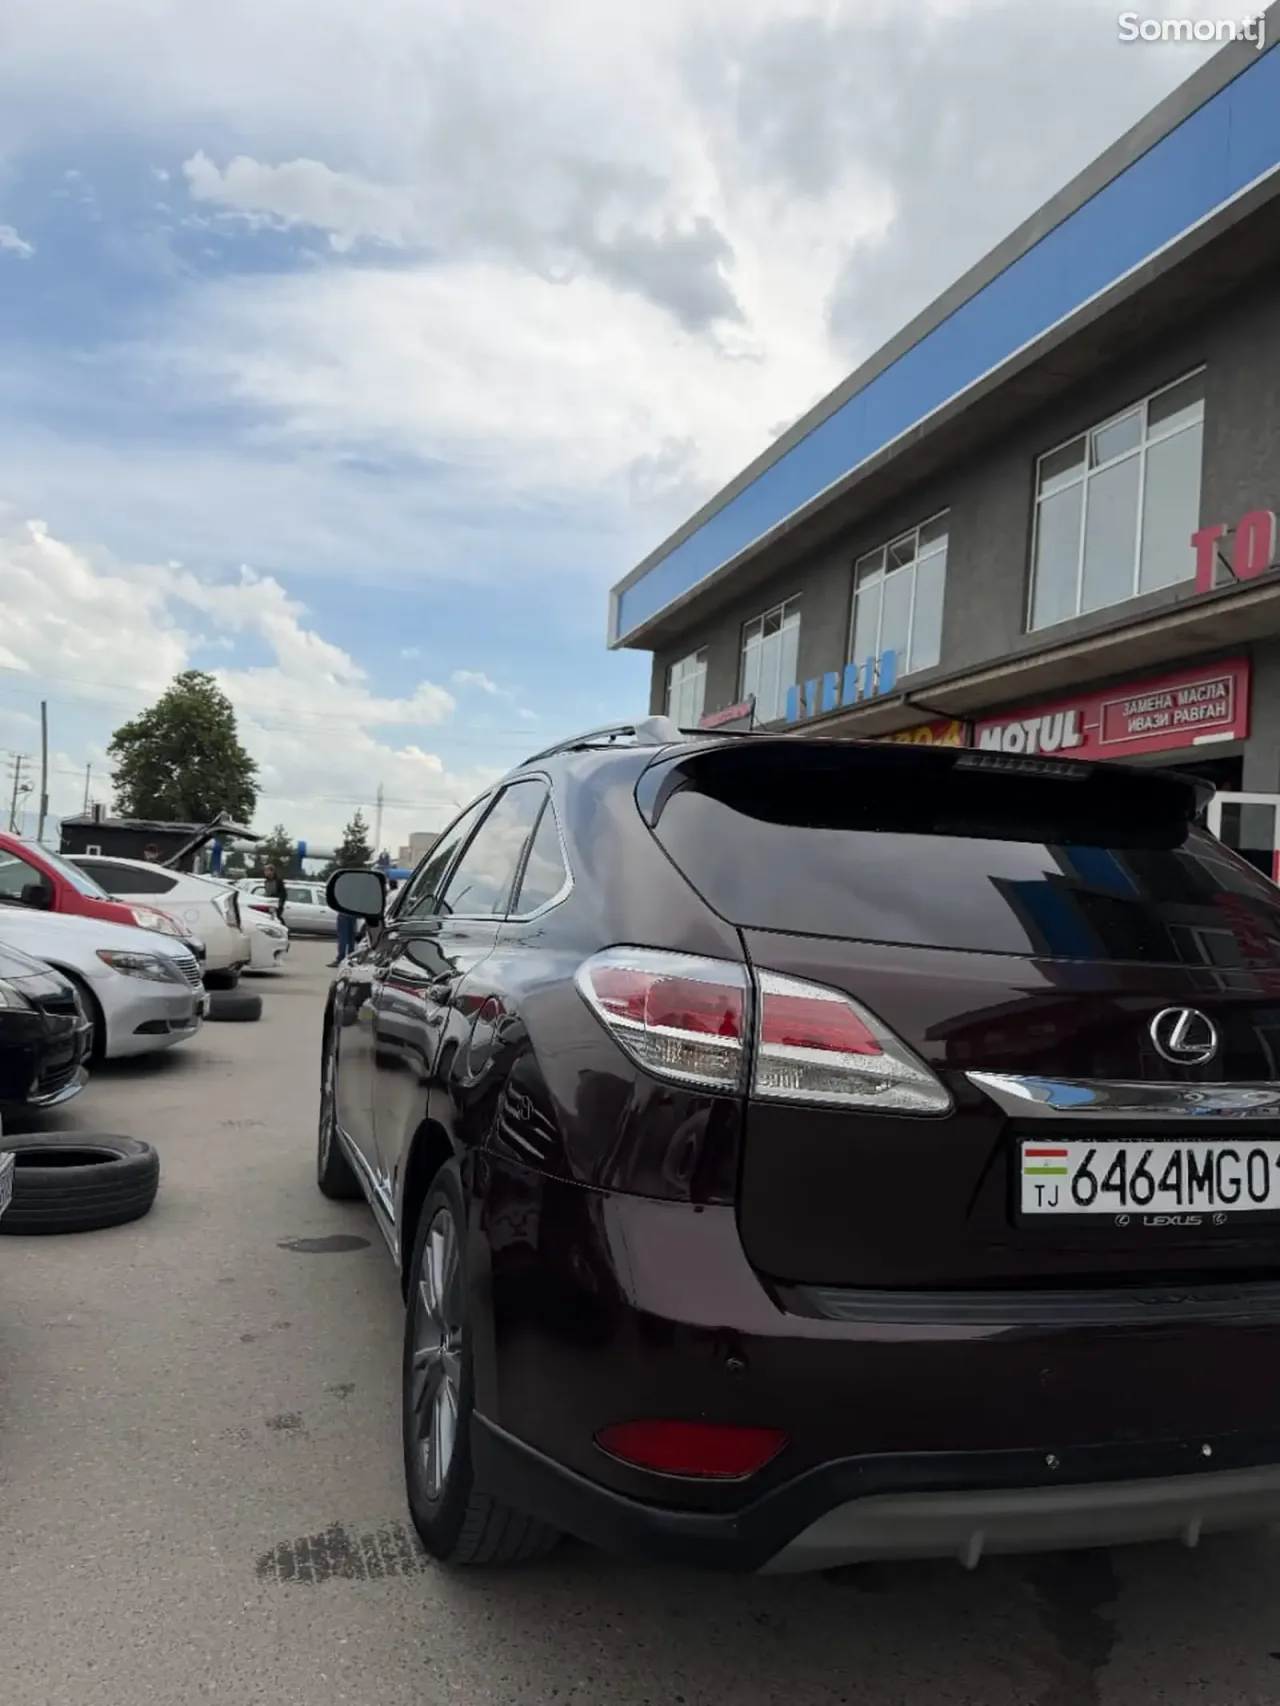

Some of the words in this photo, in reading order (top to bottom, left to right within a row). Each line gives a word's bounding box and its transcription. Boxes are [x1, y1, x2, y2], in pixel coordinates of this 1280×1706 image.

[1122, 694, 1173, 717] ЗАМЕНА
[1177, 682, 1226, 706] МАСЛА
[979, 710, 1082, 754] MOTUL
[1127, 711, 1170, 733] ИВАЗИ
[1034, 1184, 1060, 1208] TJ
[1071, 1147, 1280, 1207] 6464MG0
[1143, 1215, 1203, 1226] LEXUS
